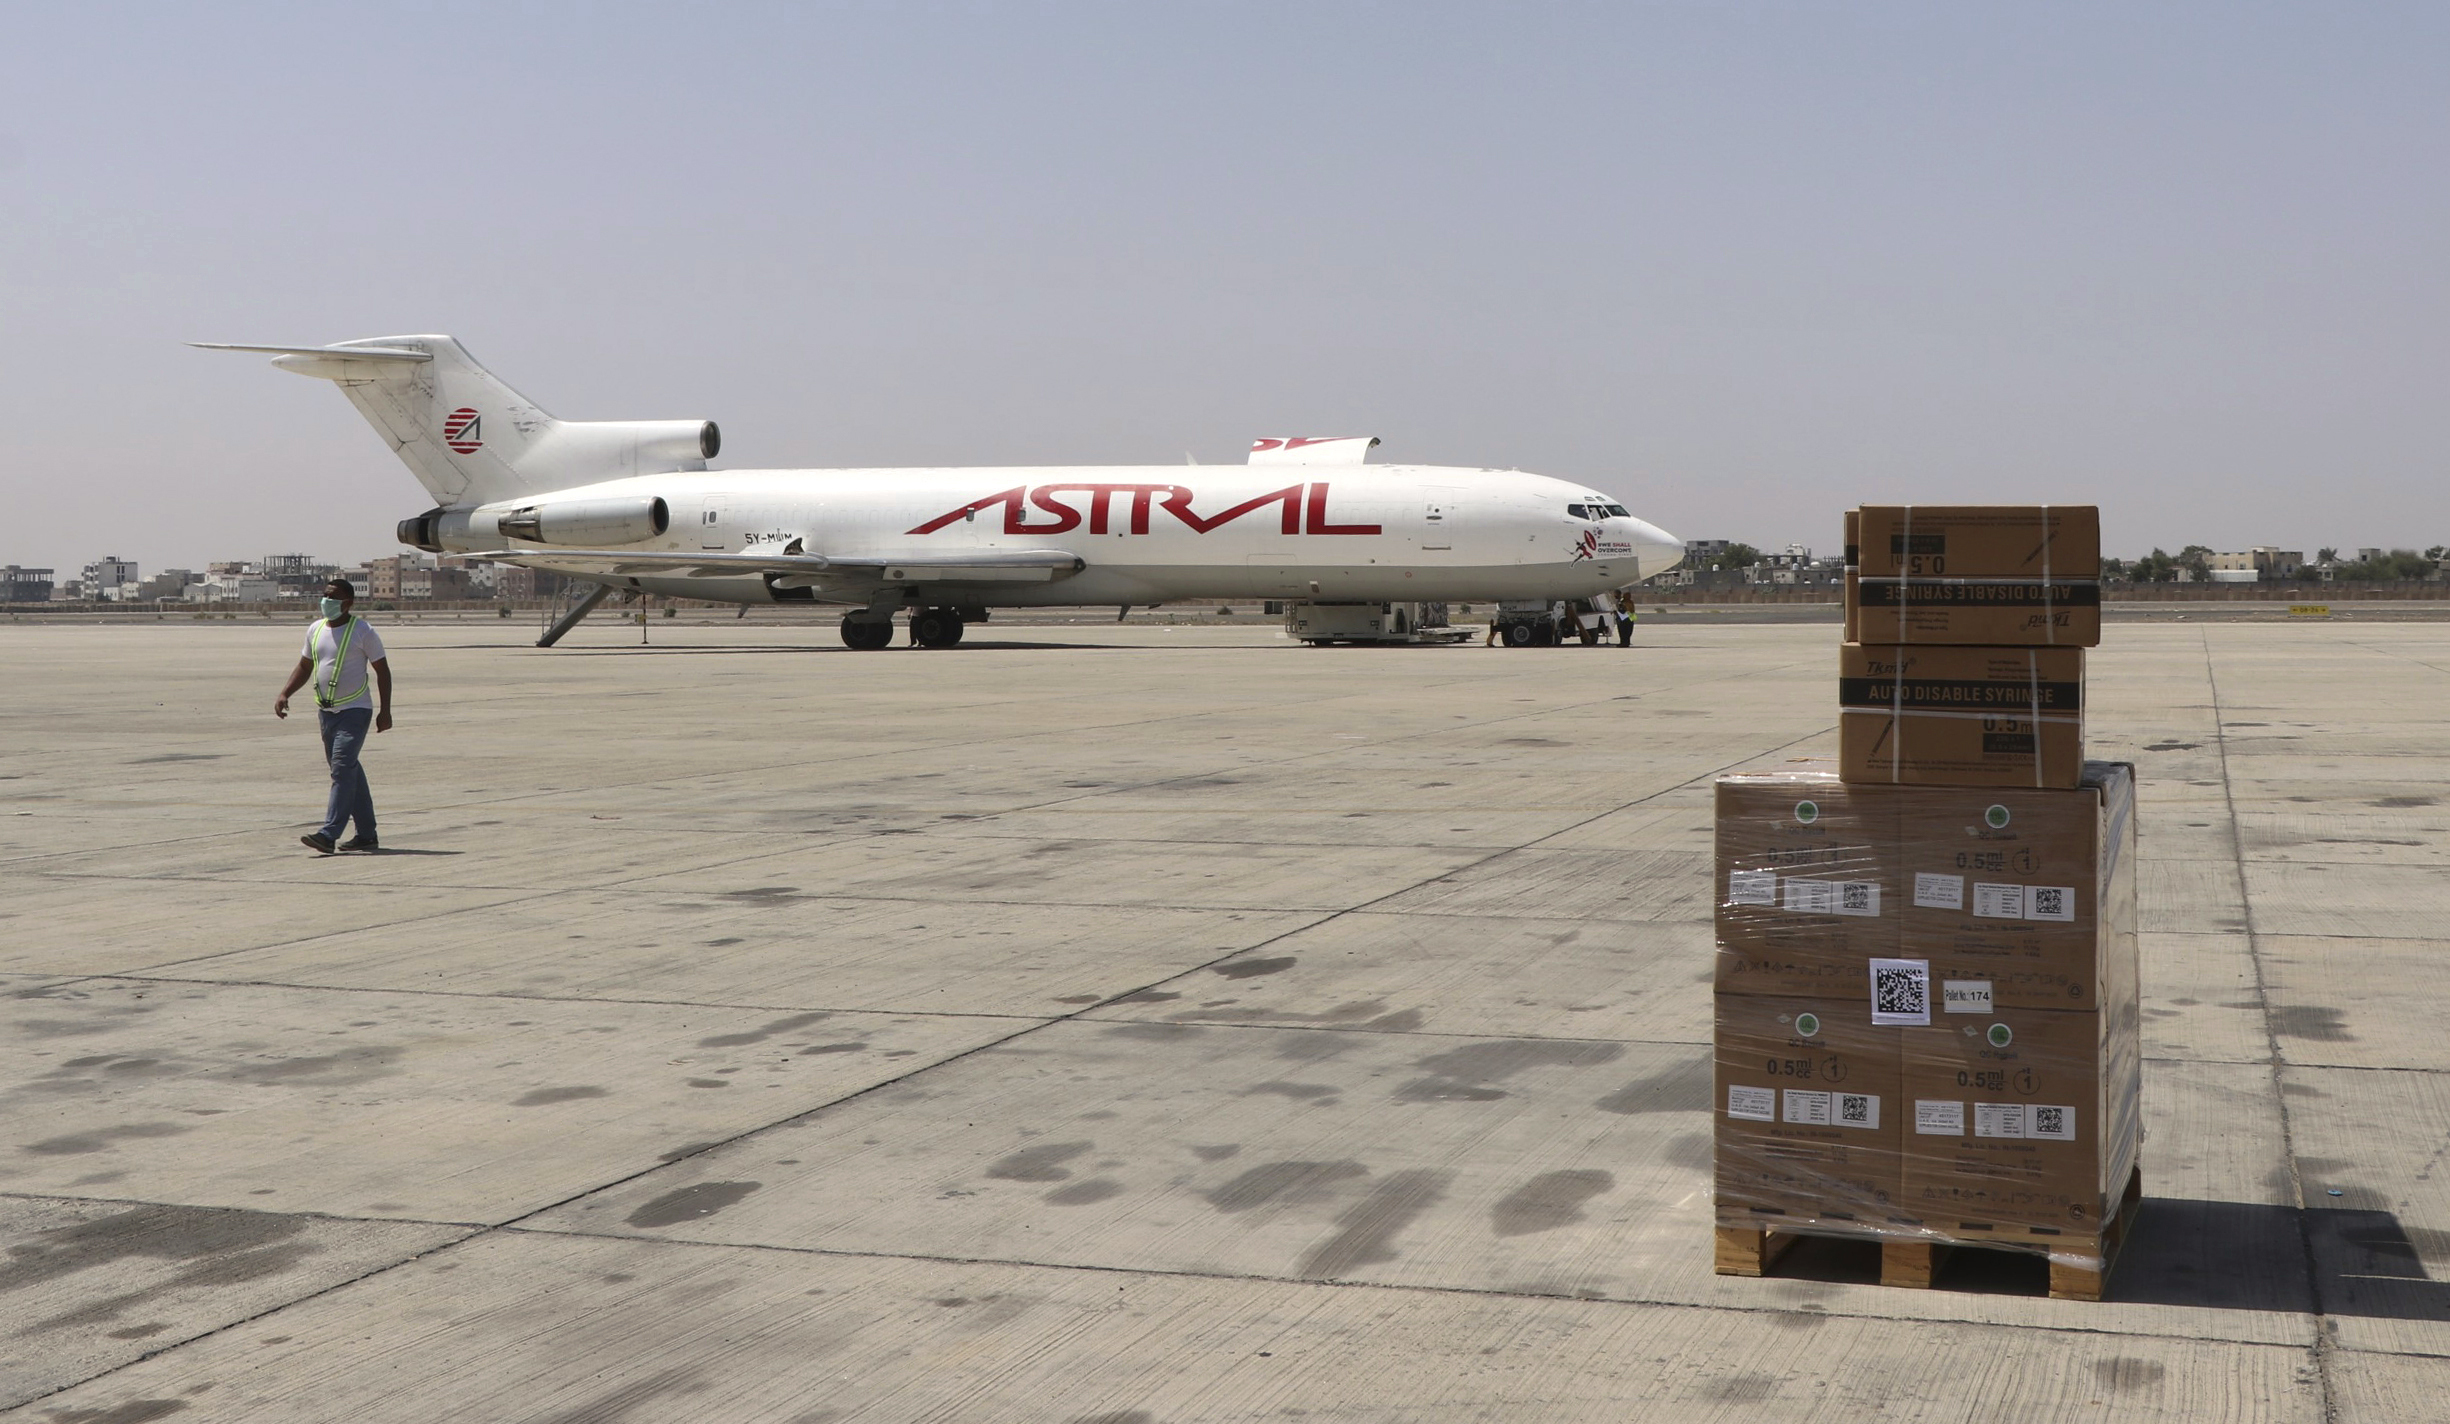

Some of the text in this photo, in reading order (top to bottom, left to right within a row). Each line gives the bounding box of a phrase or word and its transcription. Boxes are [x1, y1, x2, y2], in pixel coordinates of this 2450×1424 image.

[904, 482, 1382, 536] ASTRAL
[1910, 556, 1944, 574] 0.5
[1886, 585, 2071, 600] AUTO DISABLE SYRINGE
[1915, 686, 1981, 702] DISABLE
[1984, 688, 2054, 704] SYRINGE
[1983, 719, 2018, 732] 0.5
[1767, 846, 1796, 864] 0.5
[1956, 852, 1984, 870] 0.5
[1945, 989, 1958, 1001] Pallet
[1970, 991, 1990, 1002] 174
[1767, 1058, 1812, 1076] 0.5 ml
[1796, 1070, 1812, 1079] cc
[1830, 1064, 1838, 1078] 1
[1957, 1070, 2004, 1088] 0.5 ml
[1988, 1082, 2004, 1090] cc
[2024, 1076, 2031, 1090] 1
